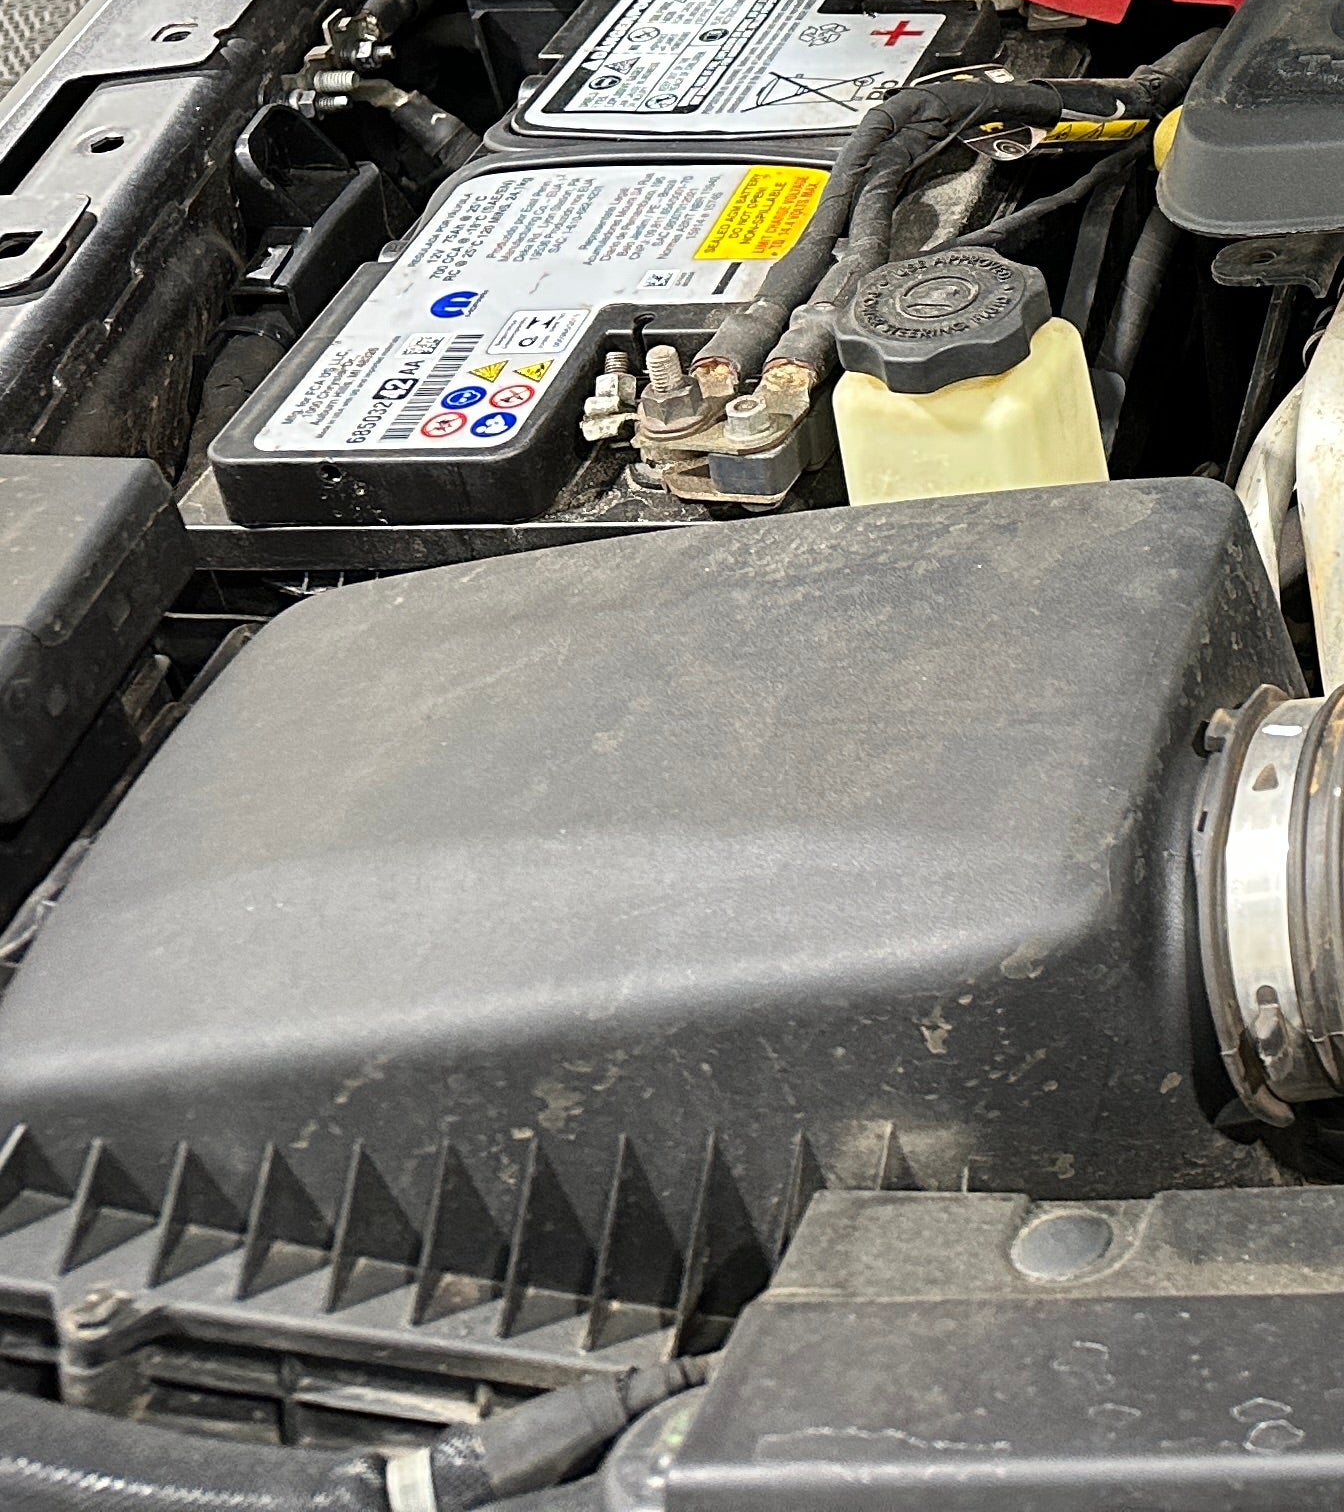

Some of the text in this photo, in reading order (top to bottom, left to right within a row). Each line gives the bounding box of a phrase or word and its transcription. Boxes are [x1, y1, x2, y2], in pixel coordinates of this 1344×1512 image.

[702, 173, 763, 252] SEALED AGM BATTERY
[727, 227, 743, 238] DO
[736, 210, 753, 224] NOT
[738, 182, 787, 243] NON-SPILLABLE
[751, 176, 809, 252] LIMIT CHARGE VOLTAGE
[768, 239, 786, 248] TO
[787, 199, 810, 218] VOLTS
[424, 249, 446, 263] 12V
[441, 223, 466, 243] 75Ah
[427, 265, 448, 279] 700
[440, 246, 463, 263] CCA
[441, 269, 462, 280] RC
[475, 225, 496, 238] 120
[304, 380, 326, 394] FCA
[344, 360, 425, 443] 685032 42 AA
